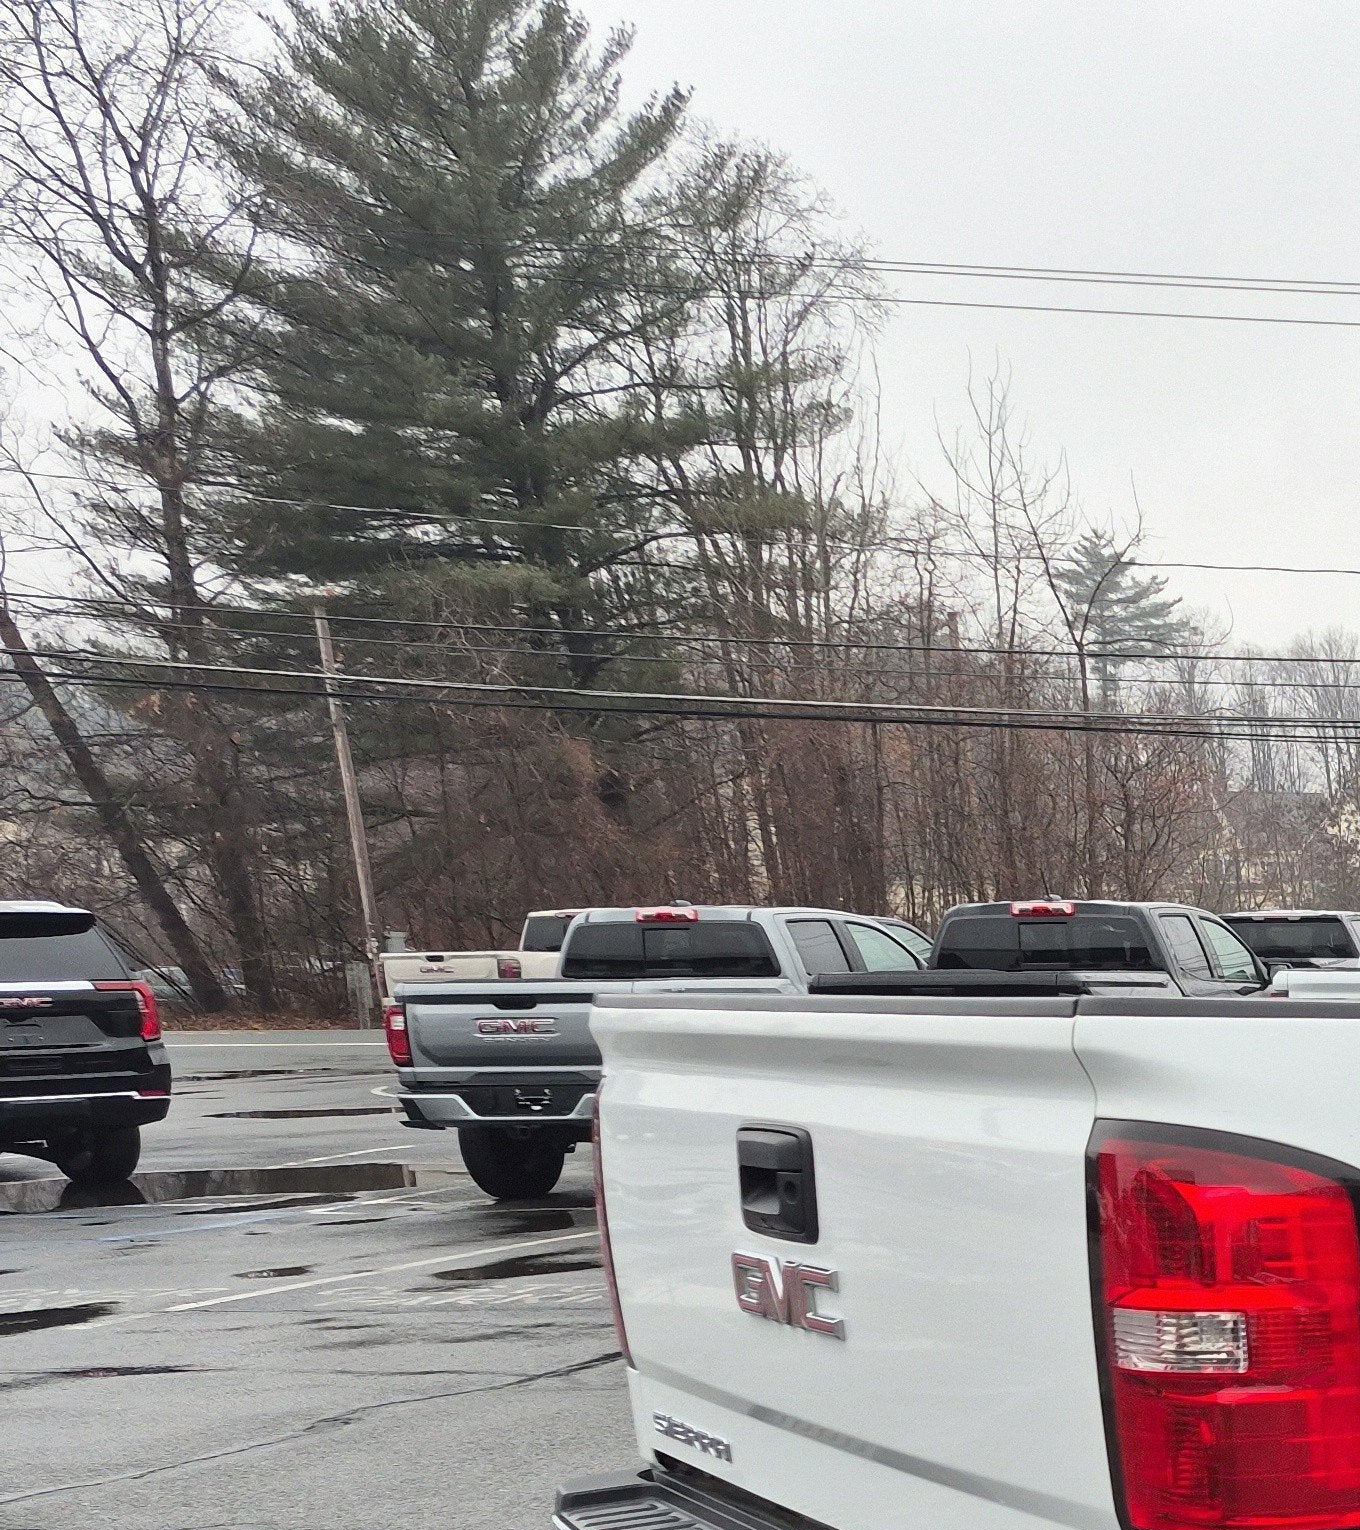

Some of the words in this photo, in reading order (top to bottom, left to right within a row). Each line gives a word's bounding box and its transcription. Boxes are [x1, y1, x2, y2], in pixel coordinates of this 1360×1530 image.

[477, 1018, 557, 1034] GMC
[731, 1249, 846, 1341] GMC
[652, 1410, 733, 1463] SIERRA
